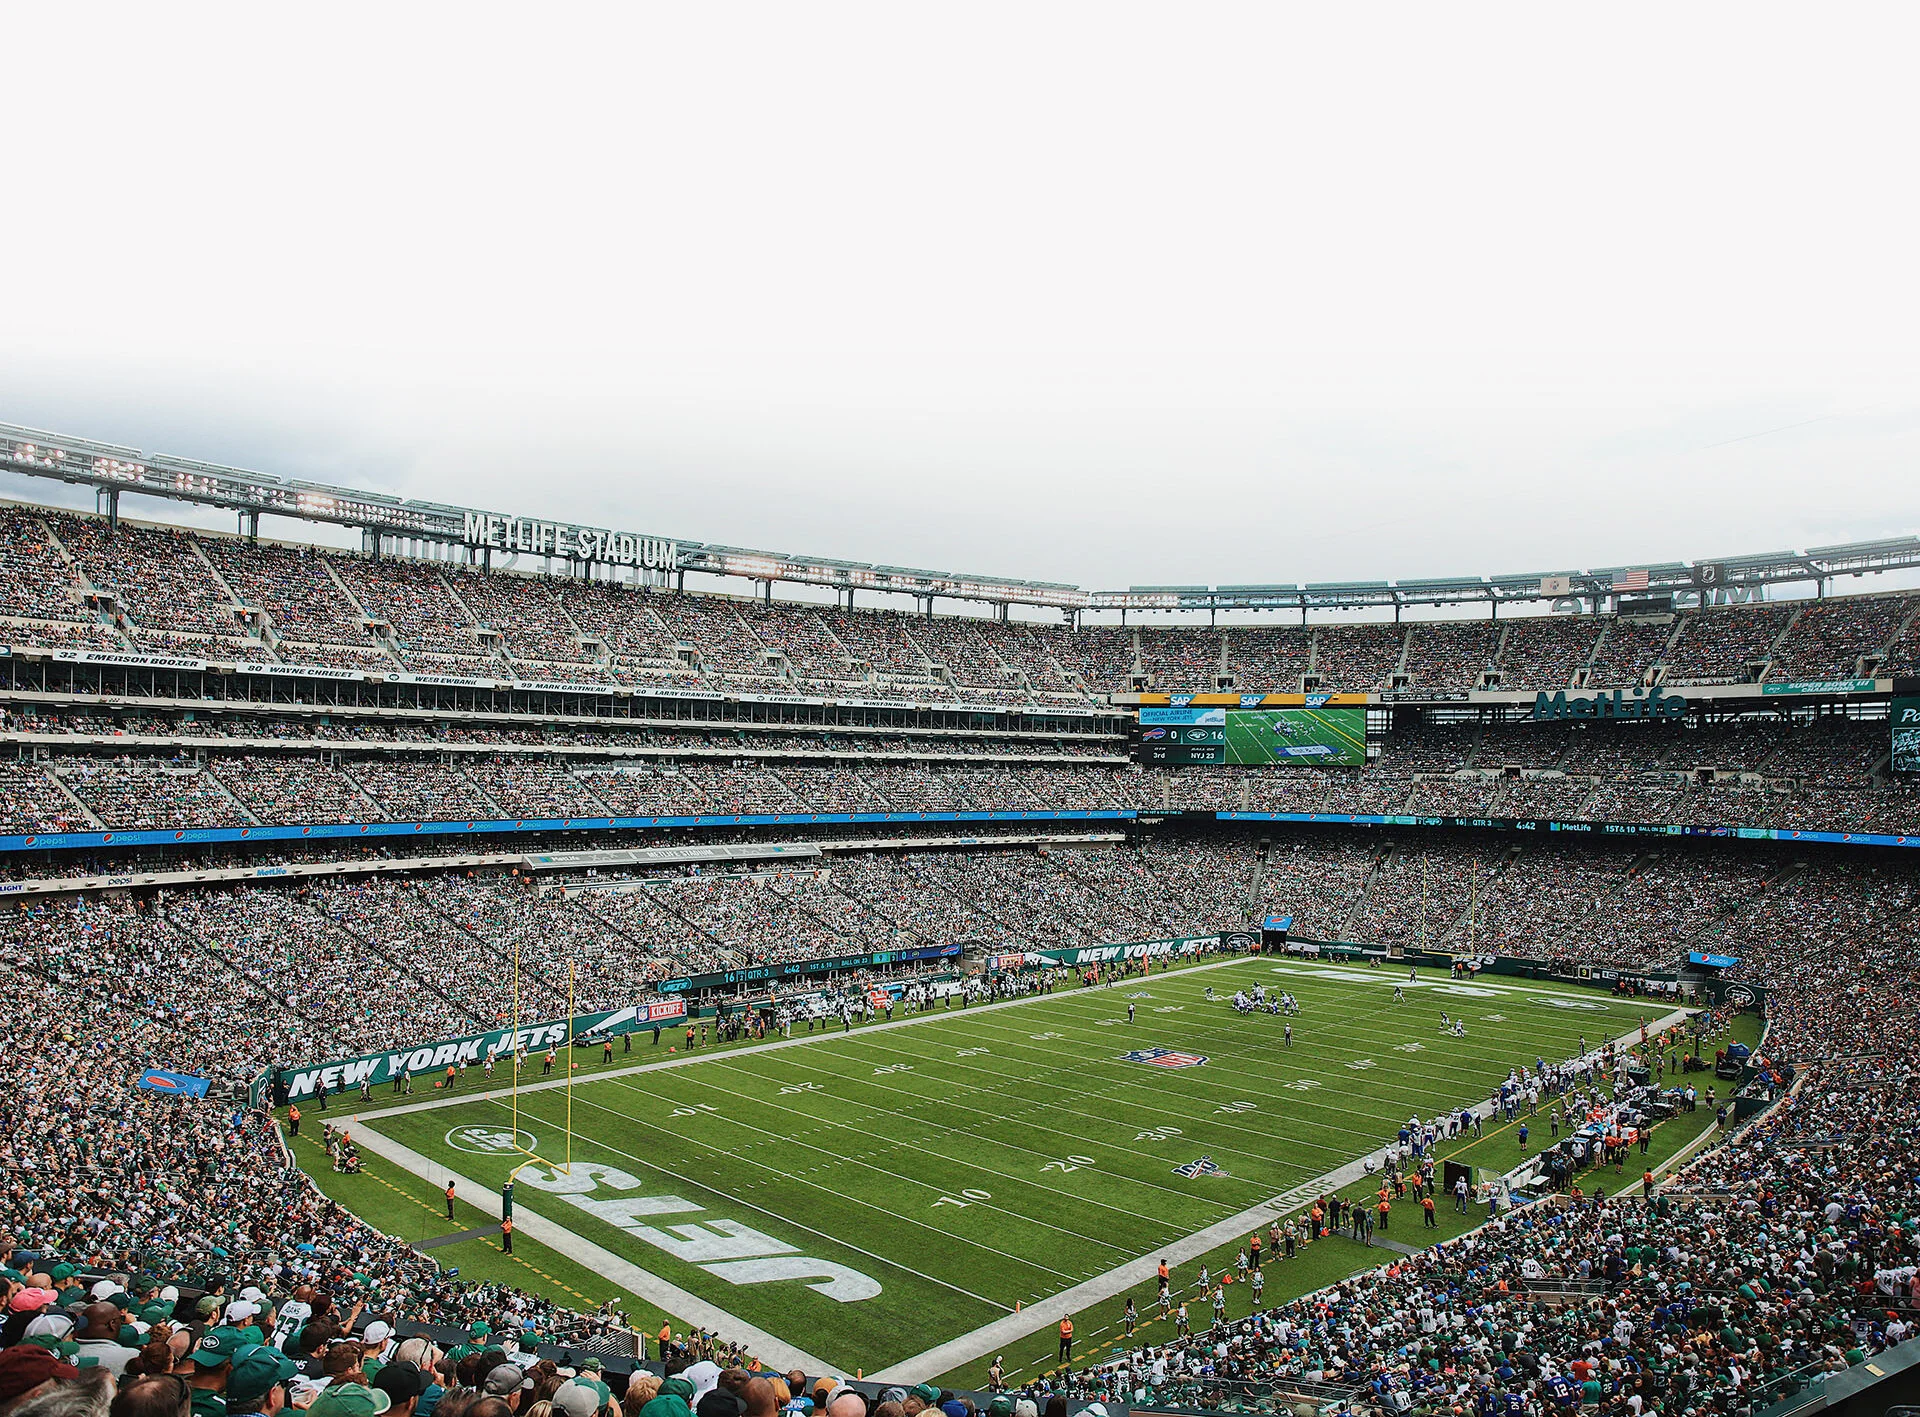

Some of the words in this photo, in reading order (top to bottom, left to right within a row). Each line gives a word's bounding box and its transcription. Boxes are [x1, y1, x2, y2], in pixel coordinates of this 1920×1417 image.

[464, 512, 568, 556] METLIFE
[578, 530, 677, 570] STADIUM
[86, 654, 148, 664] EMERSON
[150, 658, 198, 668] BOOZER
[270, 667, 304, 675] WAYNE
[1170, 697, 1190, 706] SAP
[1240, 697, 1260, 706] SAP
[1306, 697, 1326, 706] SAP
[1534, 686, 1687, 718] MetLife
[1170, 731, 1177, 739] 0
[424, 823, 443, 832] pepsi
[1516, 822, 1535, 830] 4:42
[1562, 824, 1591, 832] MetLife
[116, 834, 140, 844] pepsi
[187, 832, 210, 841] pepsi
[252, 830, 273, 838] pepsi
[40, 836, 66, 846] pepsi
[257, 868, 287, 877] MetLife
[108, 876, 133, 886] pepsi
[1076, 946, 1121, 963] NEW
[1123, 941, 1175, 959] YORK
[1178, 936, 1221, 953] JETS
[902, 951, 906, 960] 0
[1453, 953, 1497, 965] JETS
[748, 970, 762, 978] QTR
[784, 965, 800, 974] 4:42
[724, 973, 735, 982] 16
[1271, 968, 1512, 996] JETS
[663, 982, 688, 992] JETS
[651, 1004, 681, 1017] KICKOFF
[288, 1058, 383, 1098] NEW
[387, 1038, 486, 1078] YORK
[487, 1022, 568, 1053] JETS
[877, 1064, 914, 1074] 30
[781, 1082, 825, 1094] 20
[1283, 1079, 1322, 1091] 50
[672, 1103, 719, 1116] 10
[1219, 1101, 1257, 1113] 40
[1138, 1126, 1182, 1141] 30
[1045, 1155, 1095, 1173] 20
[939, 1189, 991, 1208] 10
[1264, 1179, 1336, 1212] KICKOFF
[510, 1162, 883, 1303] JETS
[1528, 1264, 1536, 1273] 12
[1622, 1328, 1631, 1337] 14
[1812, 1325, 1821, 1334] 26
[1653, 1375, 1665, 1387] 12
[1554, 1384, 1568, 1396] 12
[1402, 1396, 1411, 1406] 14
[1485, 1403, 1493, 1412] 14
